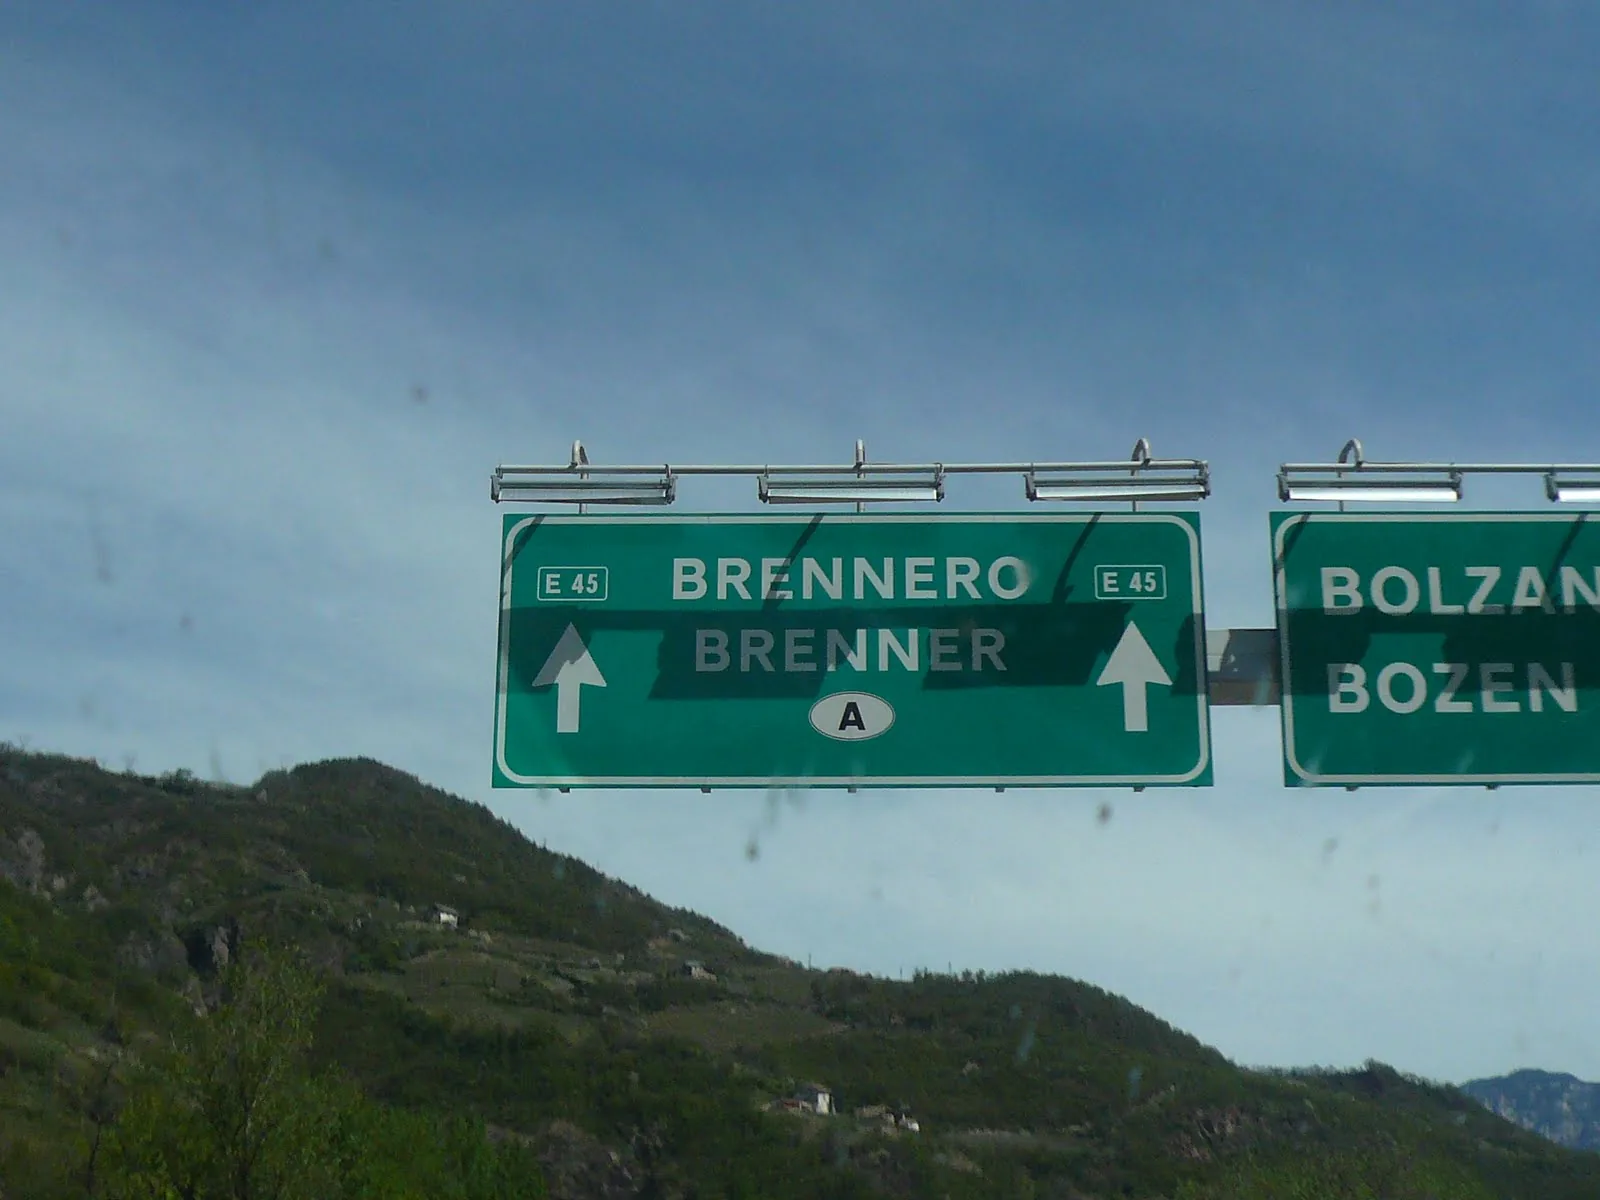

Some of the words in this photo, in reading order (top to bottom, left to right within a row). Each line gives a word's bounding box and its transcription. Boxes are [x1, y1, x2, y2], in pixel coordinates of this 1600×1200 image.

[545, 574, 561, 594] E
[571, 573, 598, 594] 45
[672, 556, 1030, 600] BRENNERO
[1102, 572, 1119, 593] E
[1129, 572, 1157, 593] 45
[695, 628, 1008, 672] BRENNER
[1326, 662, 1578, 713] BOZEN
[838, 701, 866, 731] A
